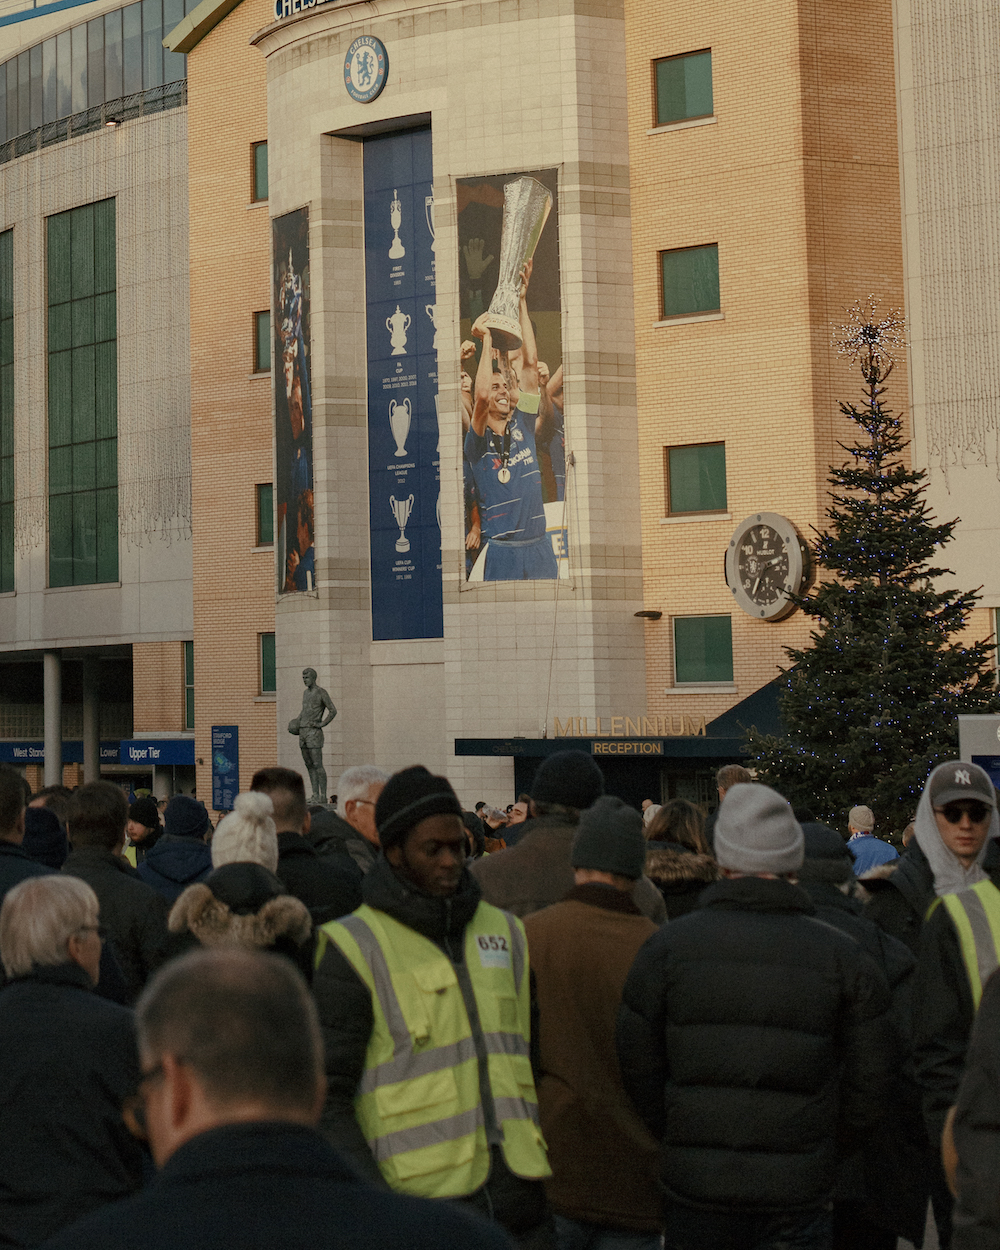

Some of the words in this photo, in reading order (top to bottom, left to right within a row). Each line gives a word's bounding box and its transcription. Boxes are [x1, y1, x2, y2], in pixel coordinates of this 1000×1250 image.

[350, 37, 377, 55] CHELSEA
[760, 529, 770, 539] 12
[553, 716, 707, 738] MILLENNIUM
[13, 748, 28, 758] West
[28, 747, 45, 758] Stand
[100, 747, 119, 758] Lower
[129, 747, 148, 762] Upper
[148, 746, 161, 759] Tier
[594, 742, 661, 754] RECEPTION
[478, 936, 508, 951] 652
